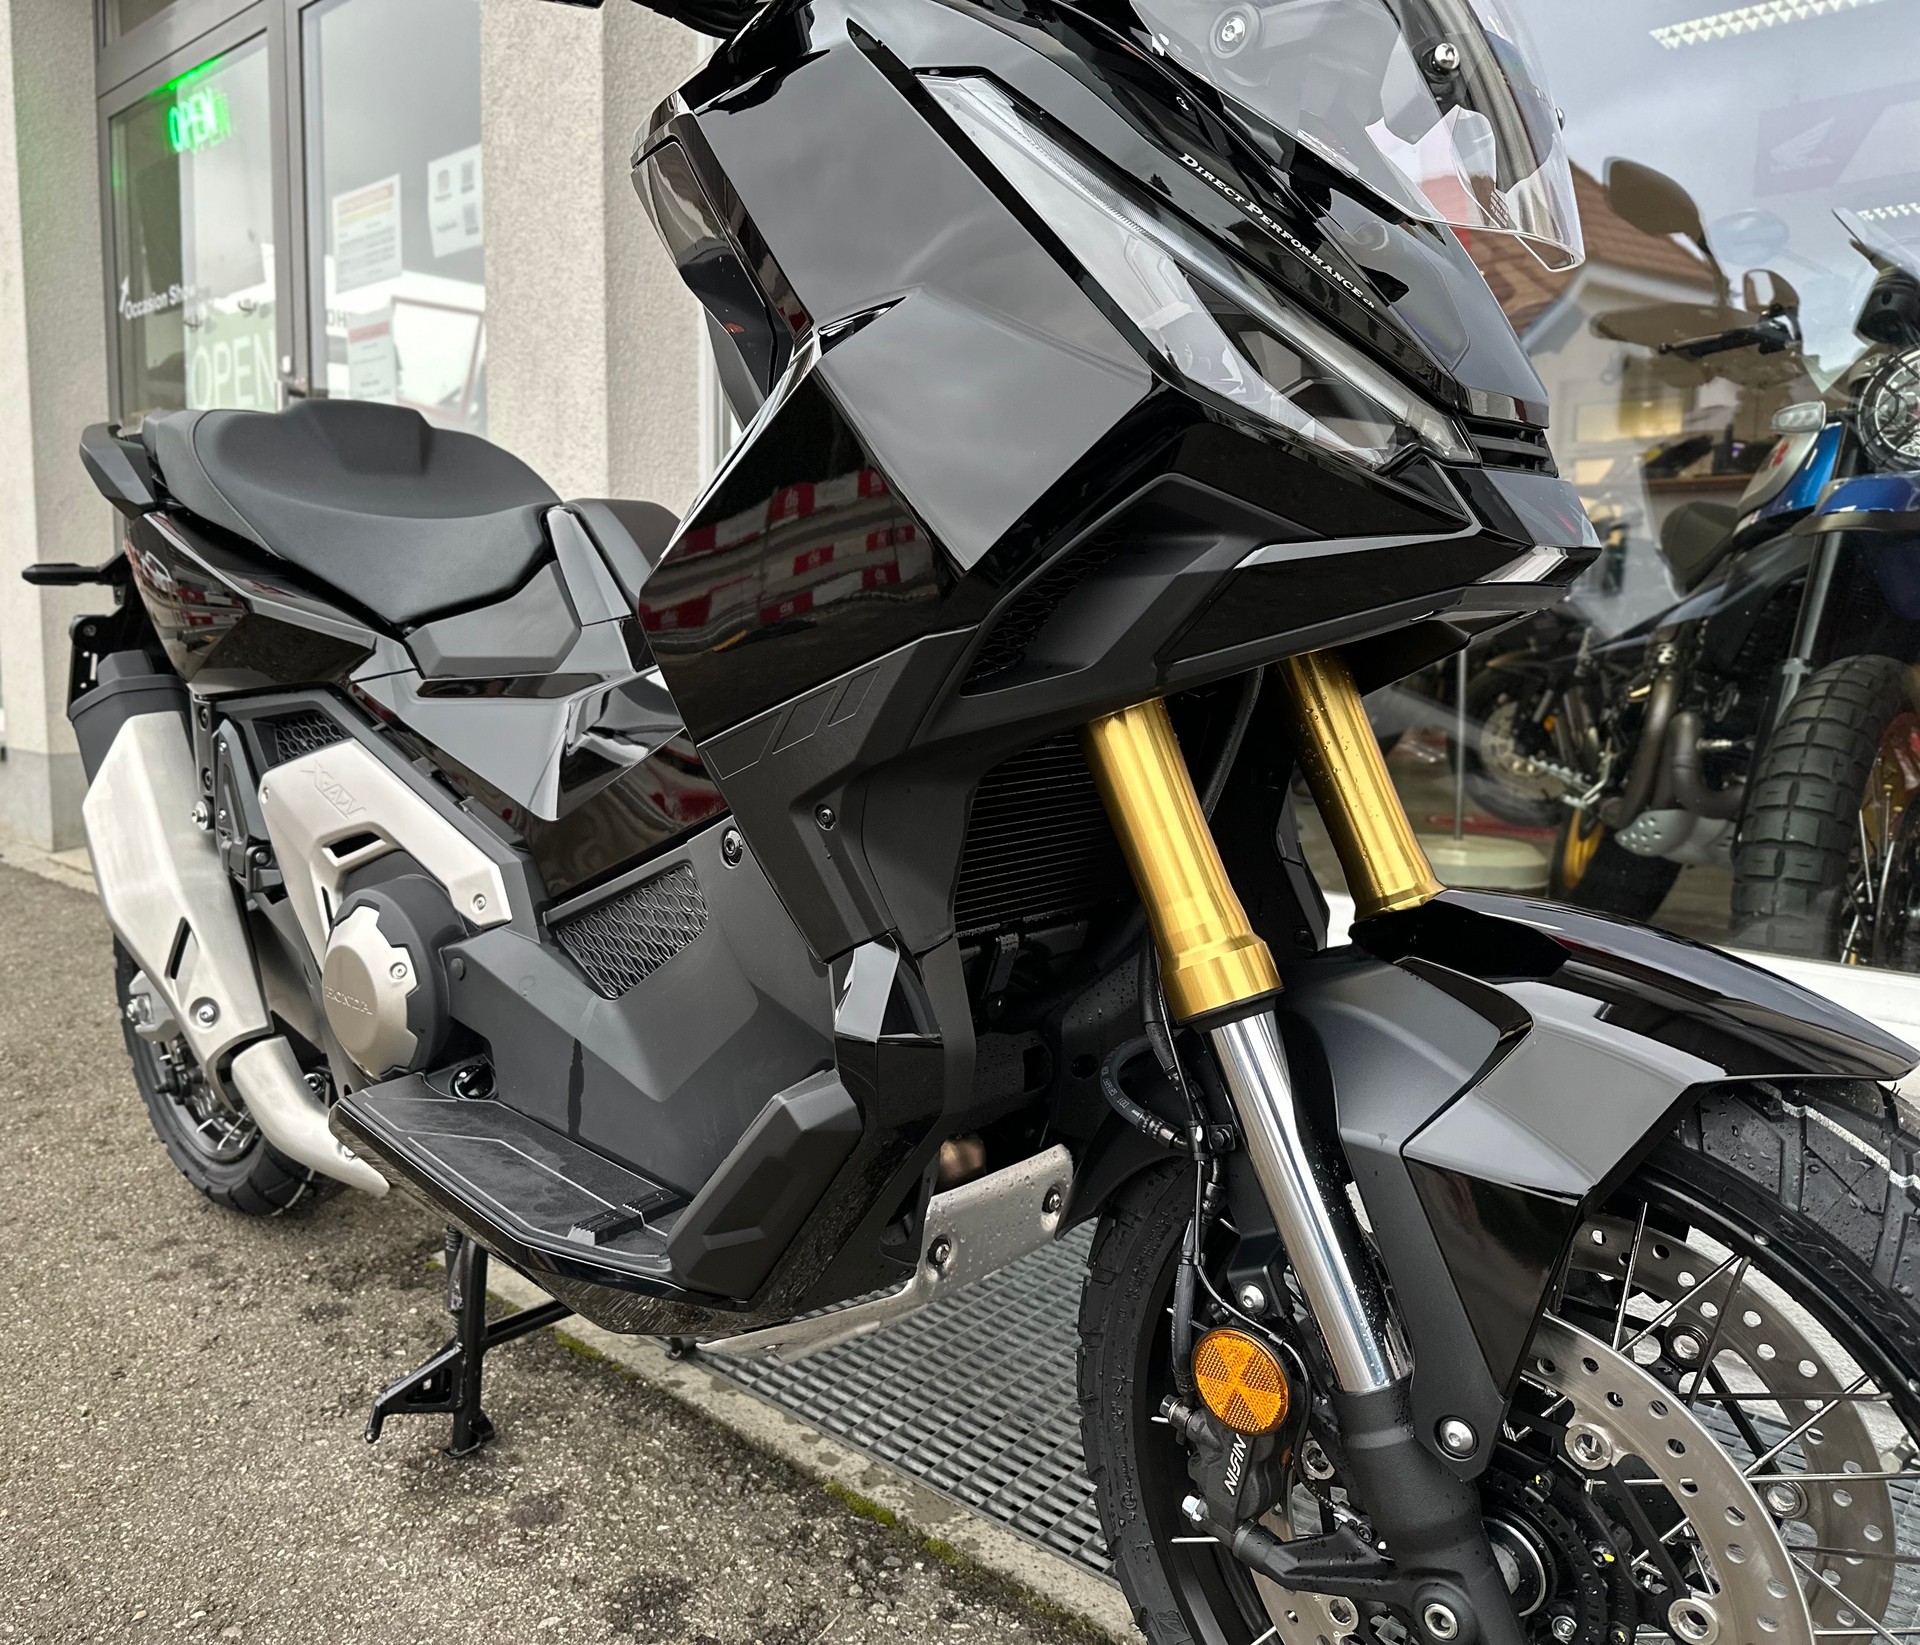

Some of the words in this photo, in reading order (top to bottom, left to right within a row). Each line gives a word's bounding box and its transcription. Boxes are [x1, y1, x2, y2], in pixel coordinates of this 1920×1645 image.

[168, 87, 218, 153] OPEN
[1179, 153, 1245, 203] DIRECT
[125, 292, 168, 320] Occasion
[190, 329, 277, 411] OPEN
[325, 985, 373, 1015] HONDA
